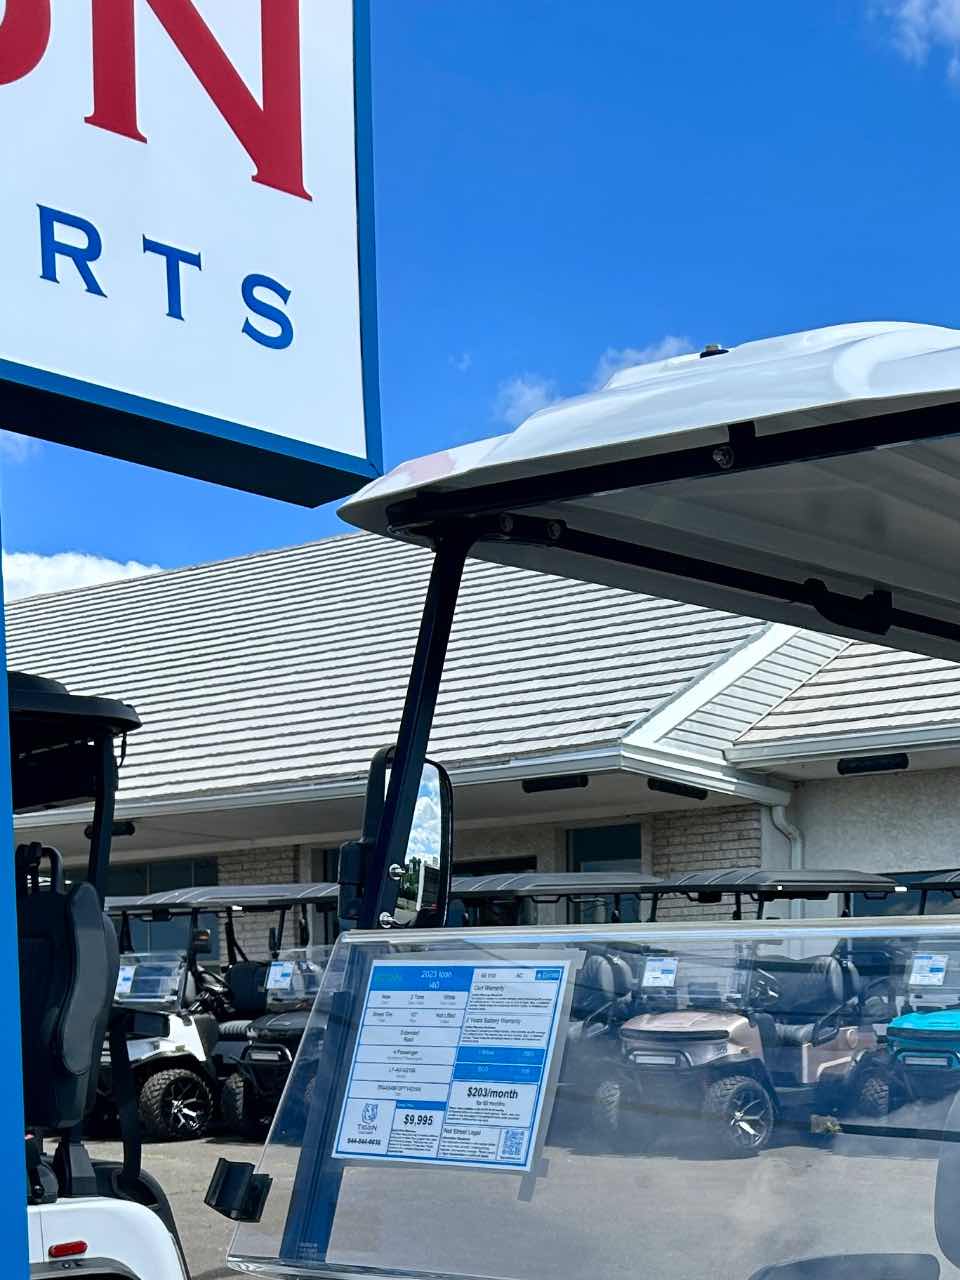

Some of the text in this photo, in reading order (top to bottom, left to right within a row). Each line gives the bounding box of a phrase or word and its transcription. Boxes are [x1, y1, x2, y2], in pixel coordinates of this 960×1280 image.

[36, 203, 294, 350] RTS
[467, 1086, 519, 1099] $203/month
[403, 1114, 434, 1126] $9,995
